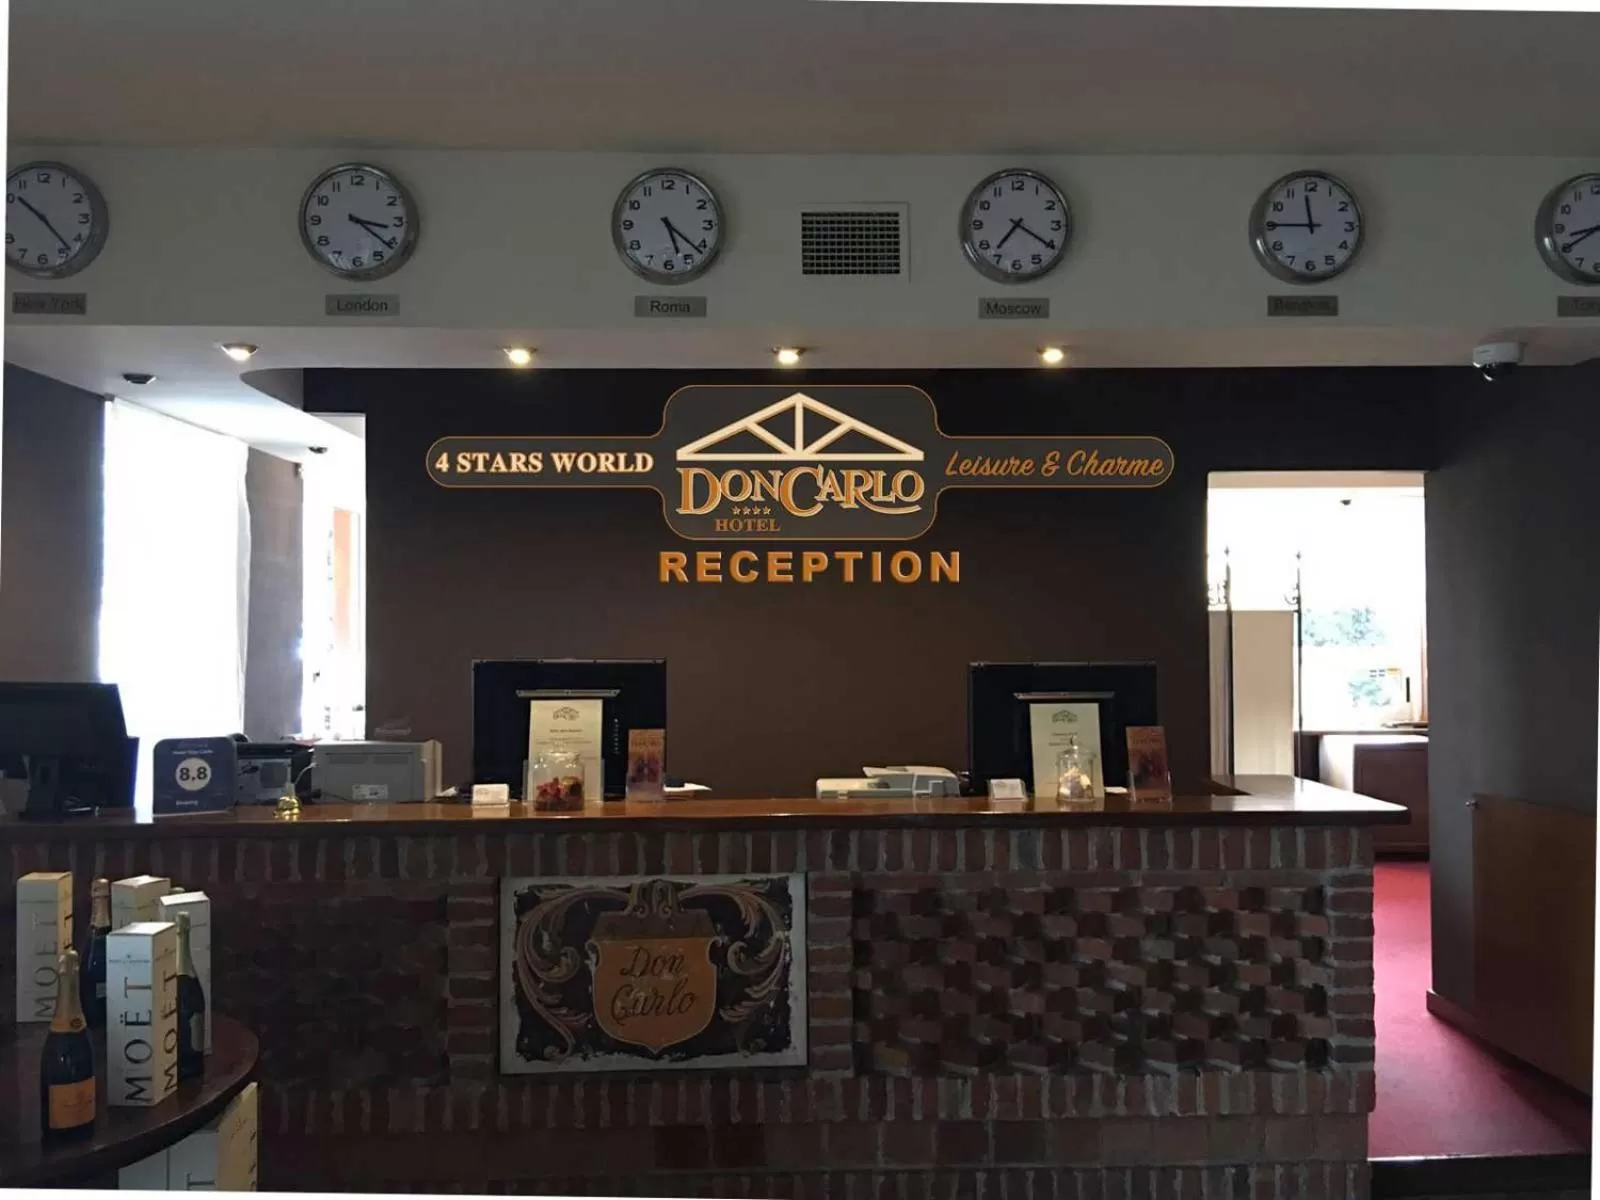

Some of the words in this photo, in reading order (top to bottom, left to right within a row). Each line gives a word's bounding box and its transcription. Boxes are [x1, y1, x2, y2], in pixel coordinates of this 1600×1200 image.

[37, 173, 51, 184] 12
[350, 175, 364, 186] 12
[332, 181, 341, 192] 11
[660, 180, 676, 190] 12
[1011, 180, 1025, 191] 12
[1304, 181, 1318, 193] 12
[643, 186, 652, 197] 11
[993, 186, 1002, 197] 11
[1286, 187, 1295, 199] 11
[1574, 191, 1582, 202] 11
[7, 193, 15, 204] 0
[73, 193, 83, 204] 2
[316, 195, 330, 207] 10
[386, 195, 398, 207] 2
[629, 200, 640, 211] 10
[696, 199, 707, 211] 2
[979, 200, 991, 211] 10
[1044, 199, 1056, 211] 2
[1271, 200, 1284, 212] 10
[1337, 200, 1349, 212] 2
[1560, 203, 1571, 215] 10
[79, 213, 90, 224] 3
[310, 215, 321, 226] 9
[392, 216, 404, 228] 3
[622, 219, 634, 231] 9
[702, 219, 714, 231] 3
[972, 219, 984, 231] 9
[1050, 219, 1062, 231] 3
[1266, 220, 1277, 231] 9
[1344, 221, 1356, 232] 3
[1554, 223, 1565, 234] 9
[317, 235, 329, 247] 8
[630, 240, 641, 251] 8
[697, 238, 707, 250] 4
[979, 240, 990, 251] 8
[1272, 240, 1284, 251] 8
[1338, 240, 1348, 250] 4
[1561, 242, 1572, 253] 8
[18, 248, 28, 261] 7
[37, 254, 48, 265] 6
[373, 251, 384, 261] 5
[644, 254, 654, 266] 7
[683, 253, 694, 265] 5
[993, 253, 1003, 265] 7
[1031, 253, 1042, 265] 5
[1286, 255, 1296, 266] 7
[1324, 255, 1336, 266] 5
[352, 256, 363, 268] 6
[663, 259, 674, 271] 6
[1012, 259, 1022, 271] 6
[1304, 260, 1316, 271] 6
[1574, 256, 1585, 269] 7
[337, 299, 389, 312] London
[649, 300, 690, 313] Roma
[986, 302, 1042, 315] Moscow
[434, 452, 450, 473] 4
[456, 452, 543, 473] STARS
[549, 452, 654, 473] WORLD
[944, 450, 1036, 477] Leisure
[1040, 450, 1060, 477] &
[1066, 449, 1165, 476] Charme
[715, 518, 780, 532] HOTEL
[659, 550, 961, 583] RECEPTION
[619, 946, 685, 978] Don
[119, 976, 153, 1101] MOËT
